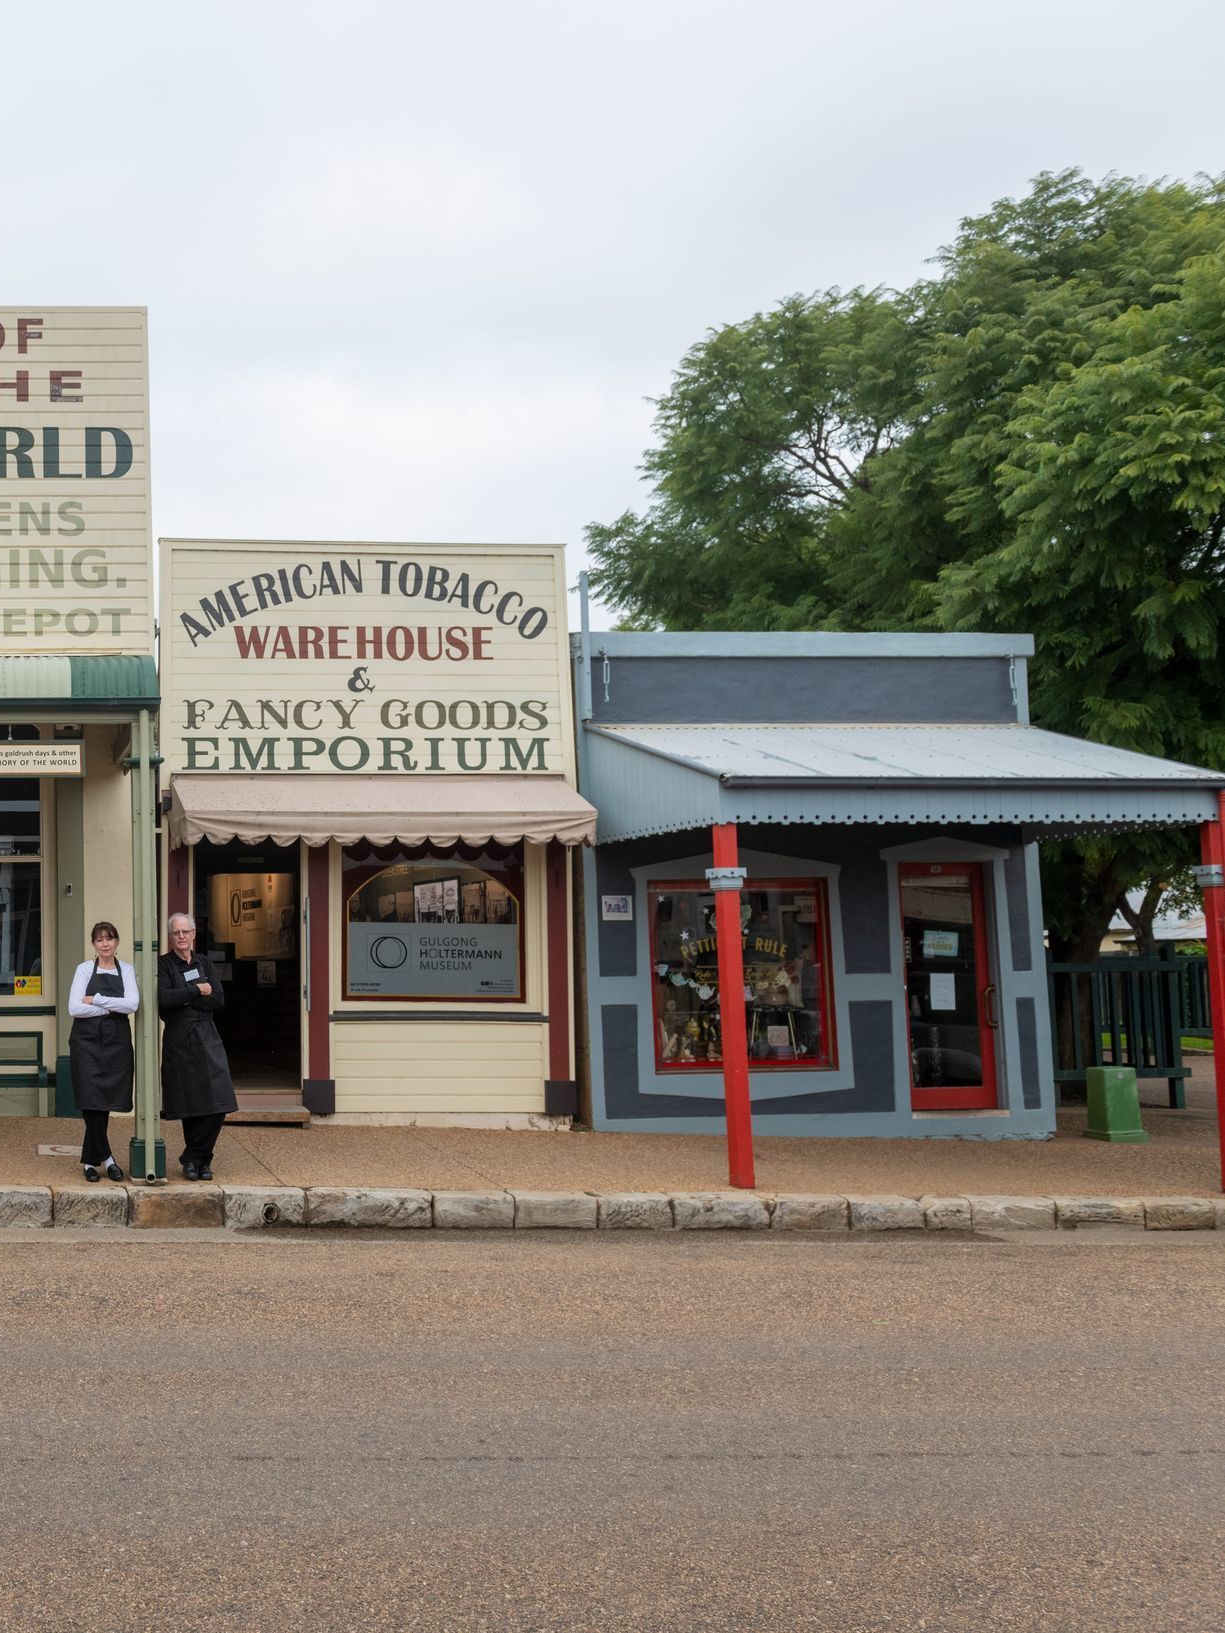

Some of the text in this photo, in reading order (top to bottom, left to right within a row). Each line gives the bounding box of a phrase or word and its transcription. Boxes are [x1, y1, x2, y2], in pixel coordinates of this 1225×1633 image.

[179, 558, 548, 647] AMERICAN TOBACCO
[233, 625, 494, 661] WAREHOUSE
[347, 666, 376, 694] &
[182, 698, 549, 731] FANCY GOODS
[4, 749, 33, 757] goldrush
[35, 749, 50, 757] days
[181, 735, 550, 771] EMPORIUM
[419, 937, 478, 947] GULGONG
[419, 948, 502, 960] HOLTERMANN
[680, 936, 789, 960] PETTIT RULE
[419, 960, 472, 971] MUSEUM
